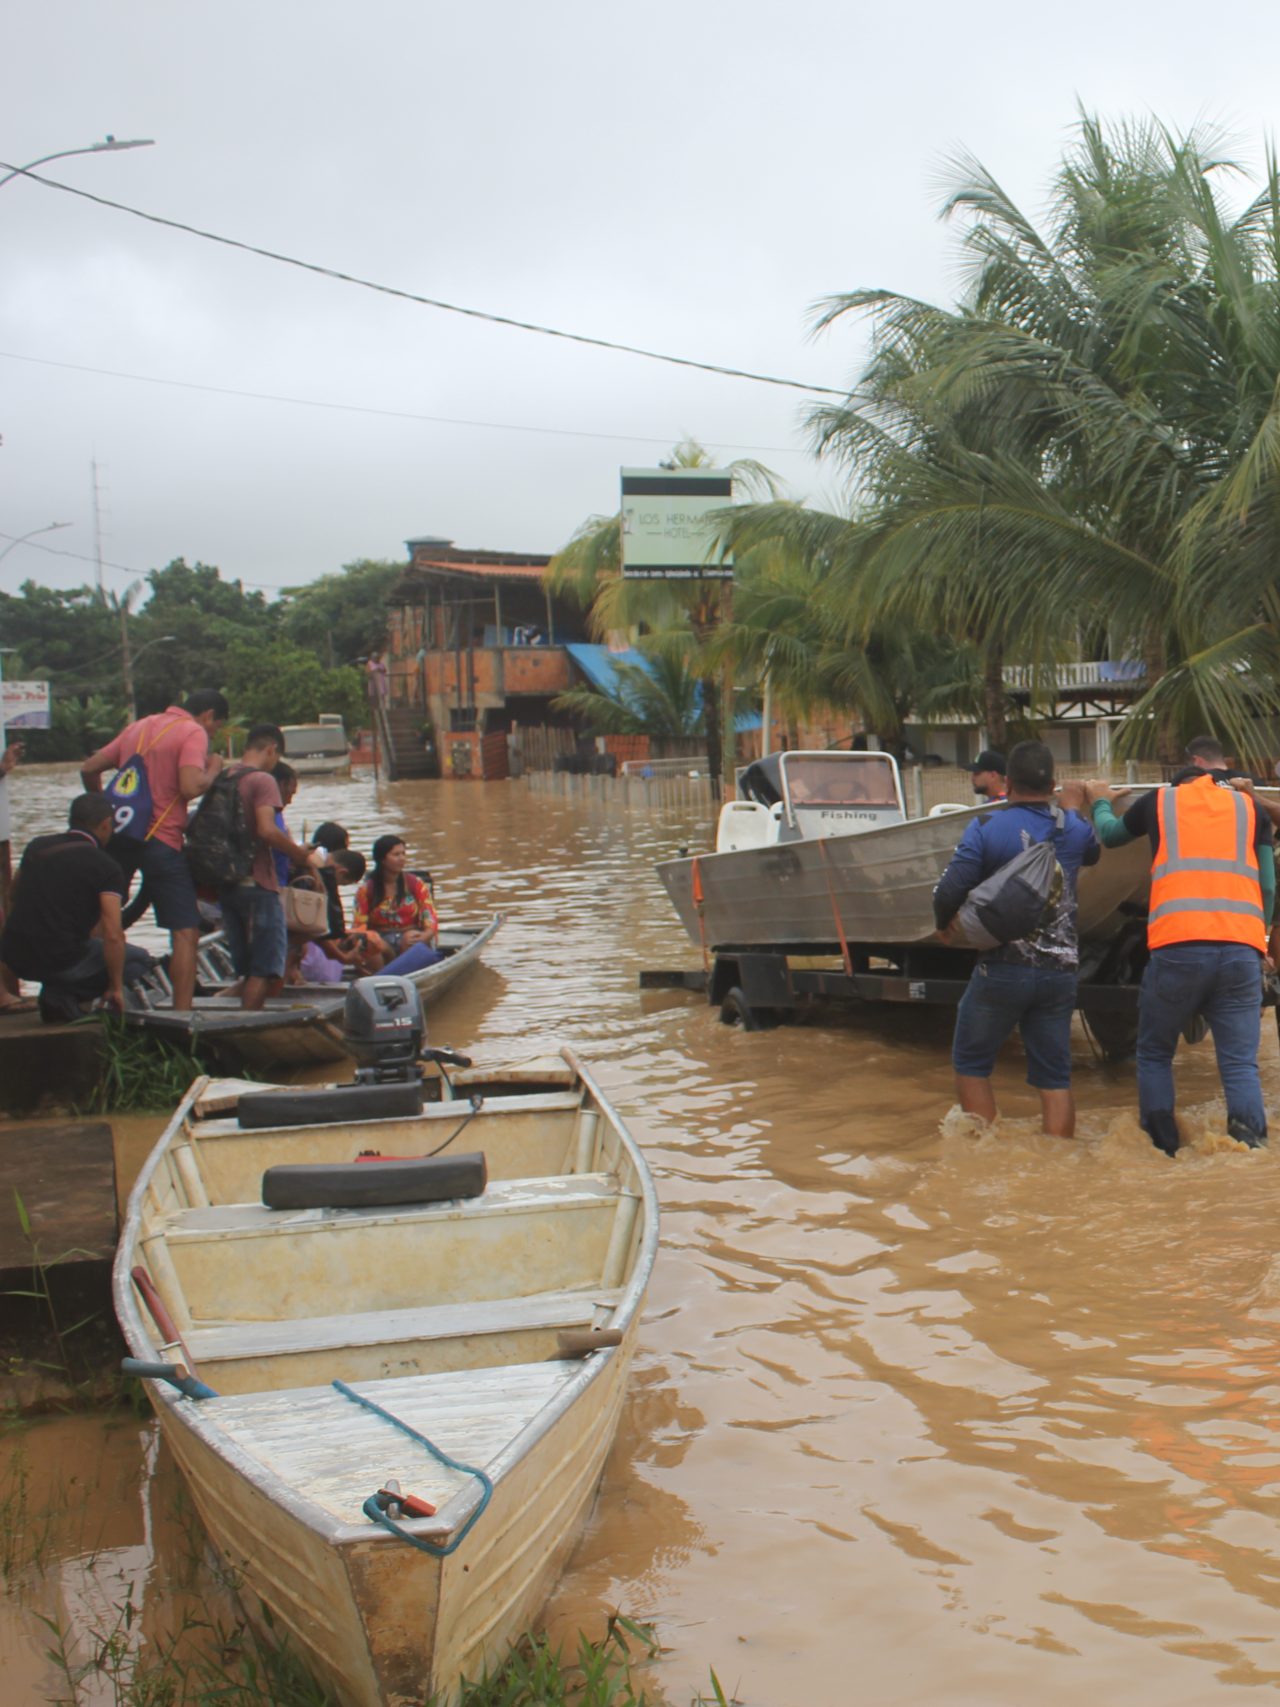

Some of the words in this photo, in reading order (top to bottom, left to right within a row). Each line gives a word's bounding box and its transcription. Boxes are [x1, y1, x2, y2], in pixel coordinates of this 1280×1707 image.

[639, 513, 660, 525] LOS
[821, 810, 878, 821] Fishing
[393, 1016, 413, 1027] 15
